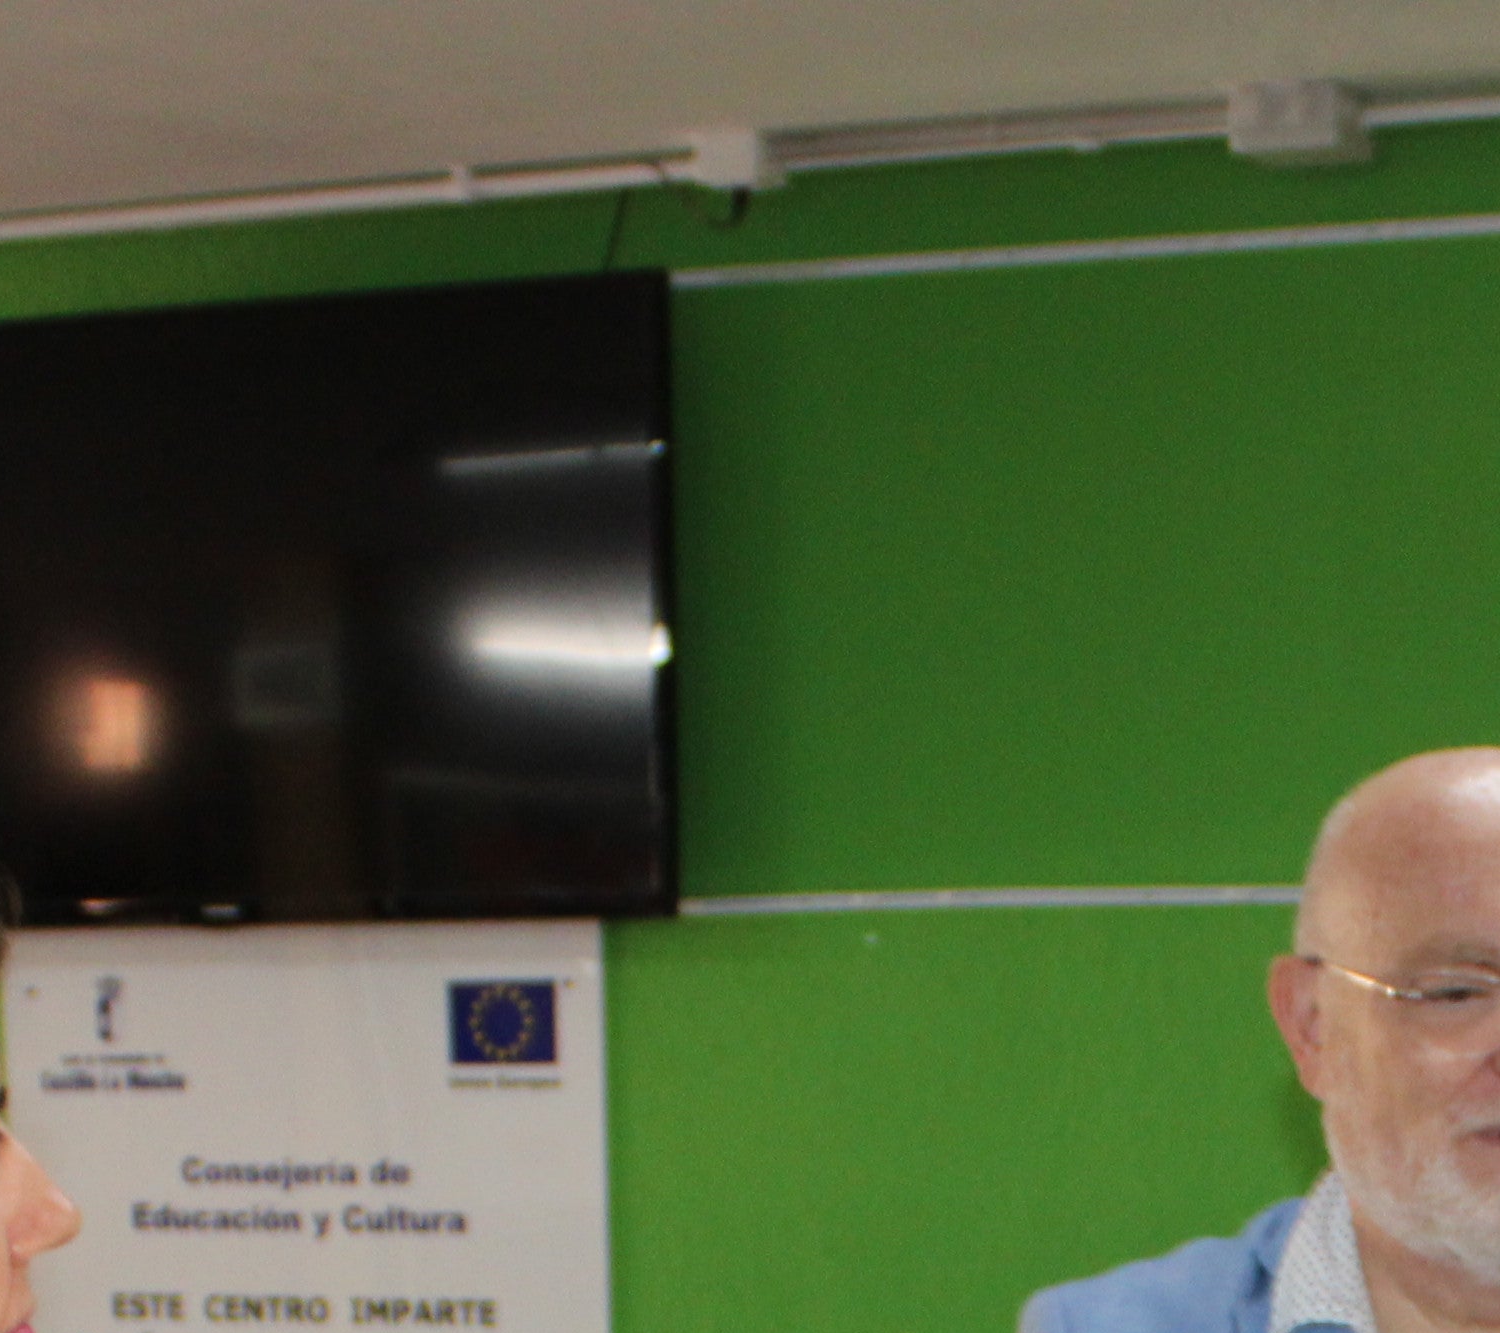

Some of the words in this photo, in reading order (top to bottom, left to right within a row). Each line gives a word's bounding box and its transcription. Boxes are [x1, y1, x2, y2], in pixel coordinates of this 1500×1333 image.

[369, 1157, 411, 1184] de
[313, 1211, 332, 1239] y
[342, 1202, 467, 1234] Cultura
[111, 1292, 187, 1321] ESTE
[204, 1293, 331, 1324] CENTRO
[349, 1296, 498, 1329] IMPARTE
